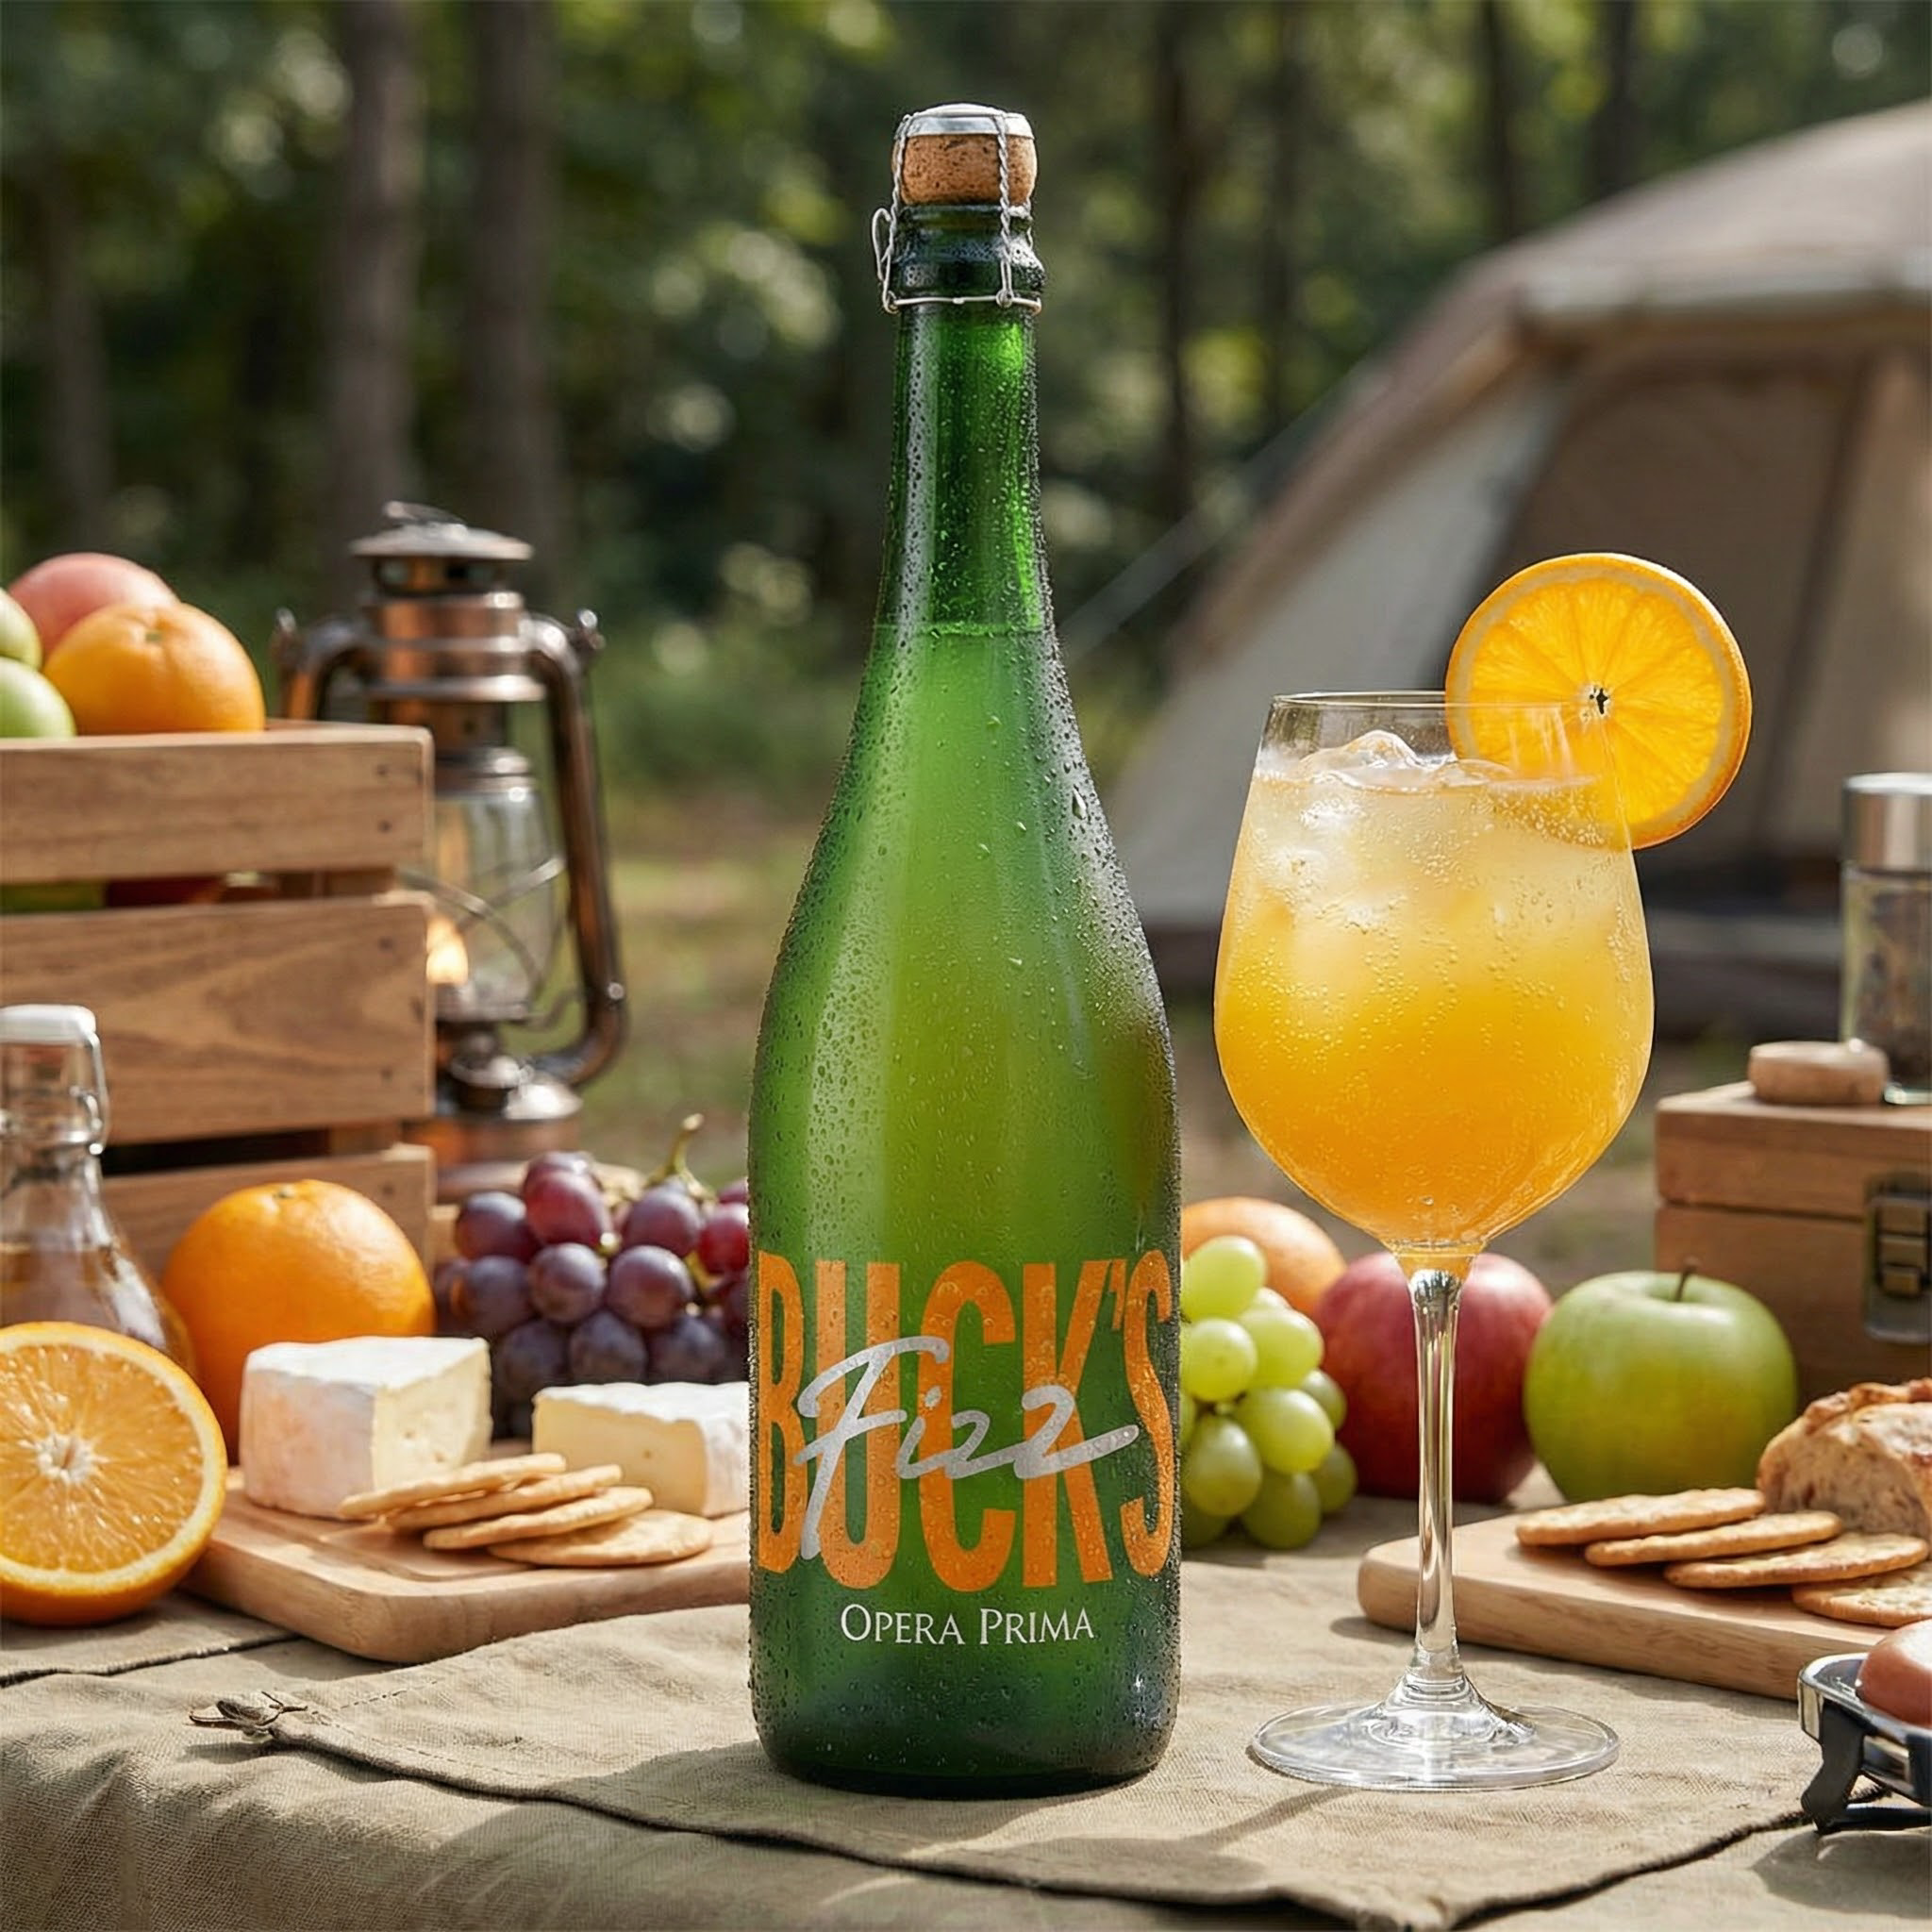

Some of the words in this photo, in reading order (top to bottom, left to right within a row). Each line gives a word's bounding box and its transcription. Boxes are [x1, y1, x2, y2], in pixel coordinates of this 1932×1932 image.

[758, 1250, 1173, 1591] BUCK'S
[794, 1336, 1139, 1559] Fizz
[841, 1604, 965, 1644] OPERA
[979, 1607, 1094, 1644] PRIMA
